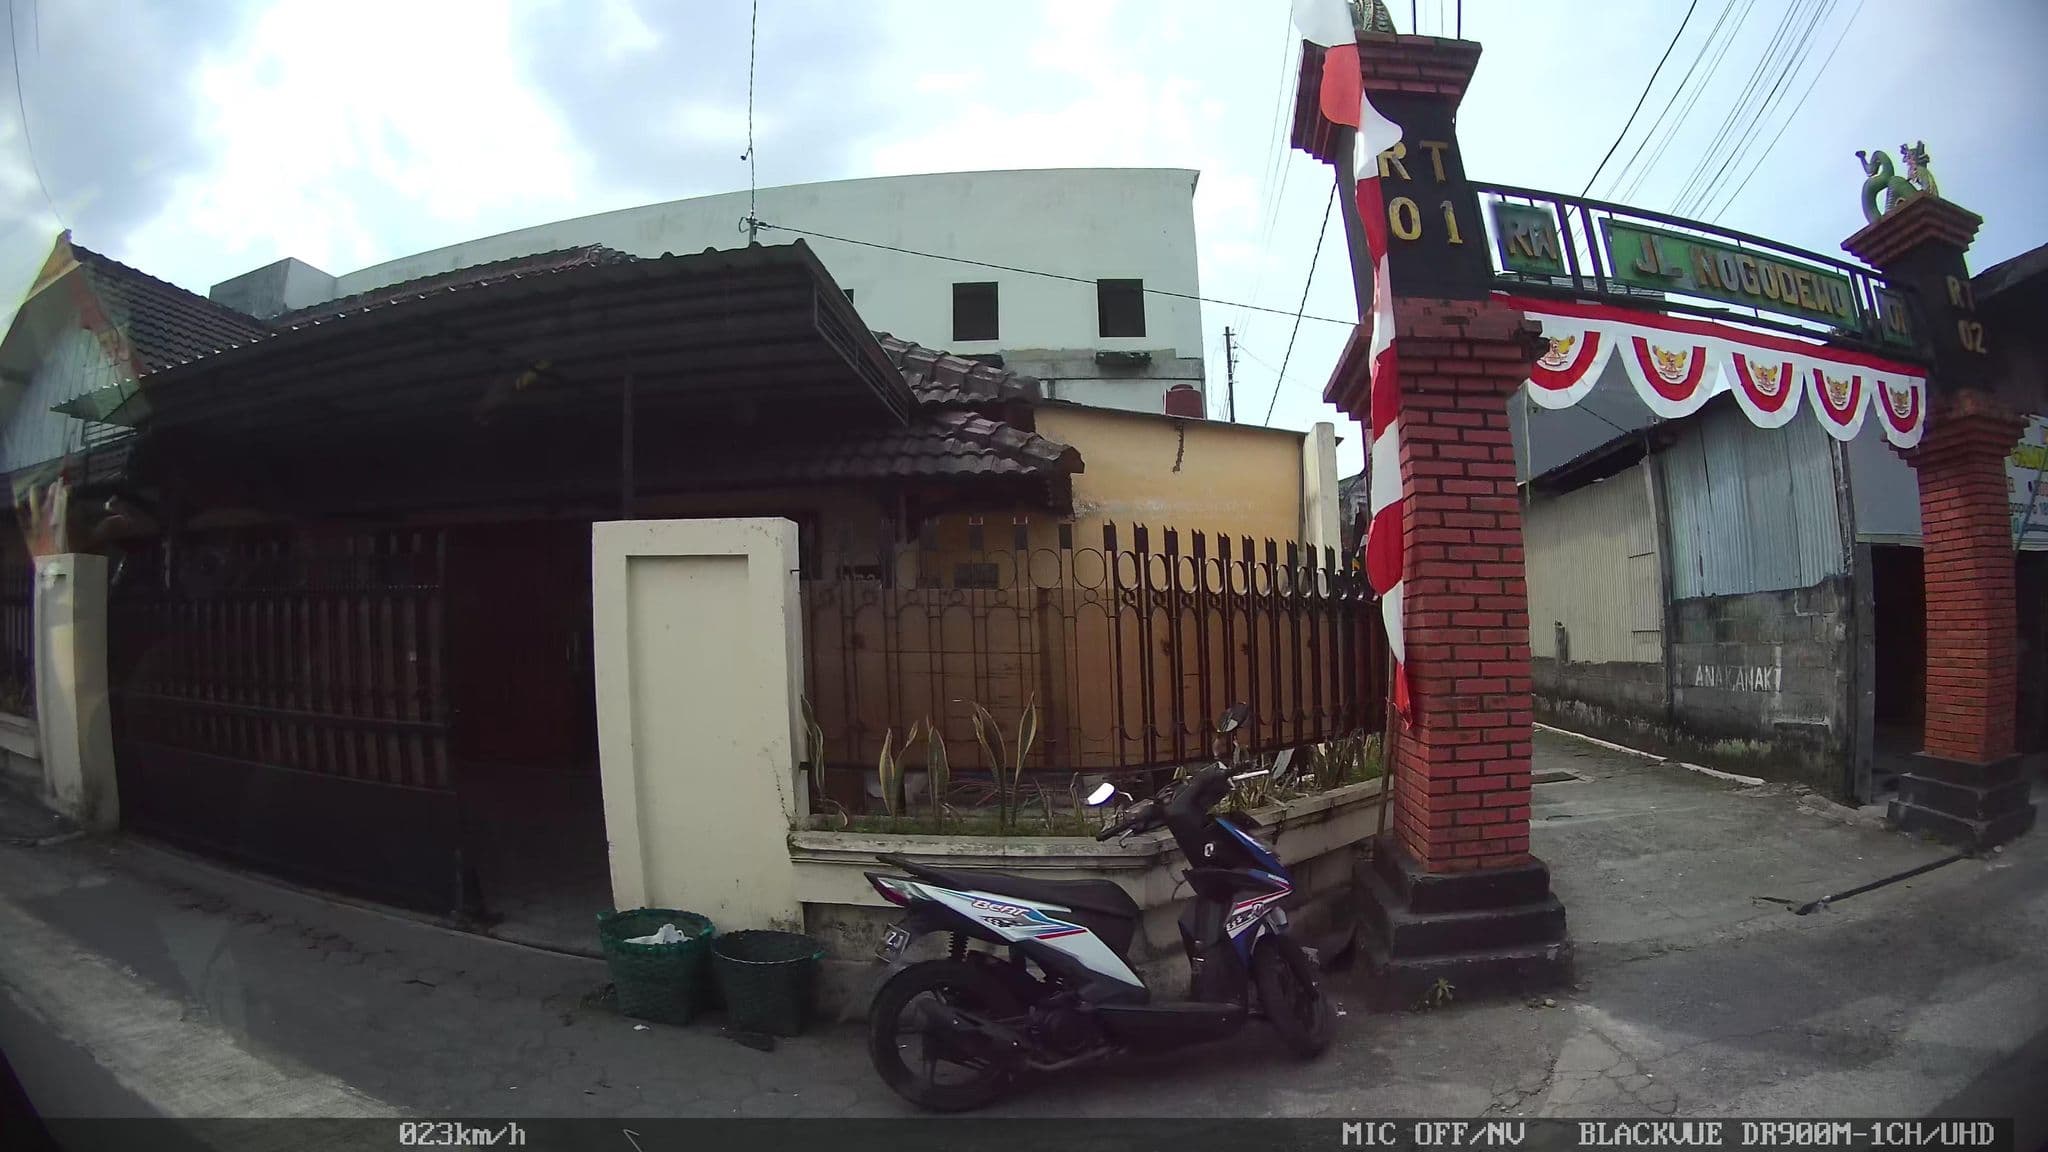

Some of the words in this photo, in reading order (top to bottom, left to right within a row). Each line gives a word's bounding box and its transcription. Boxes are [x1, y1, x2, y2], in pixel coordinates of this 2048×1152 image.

[1378, 140, 1448, 183] RT
[1388, 196, 1463, 244] 01
[1502, 219, 1558, 261] RW
[1957, 318, 1987, 354] 02
